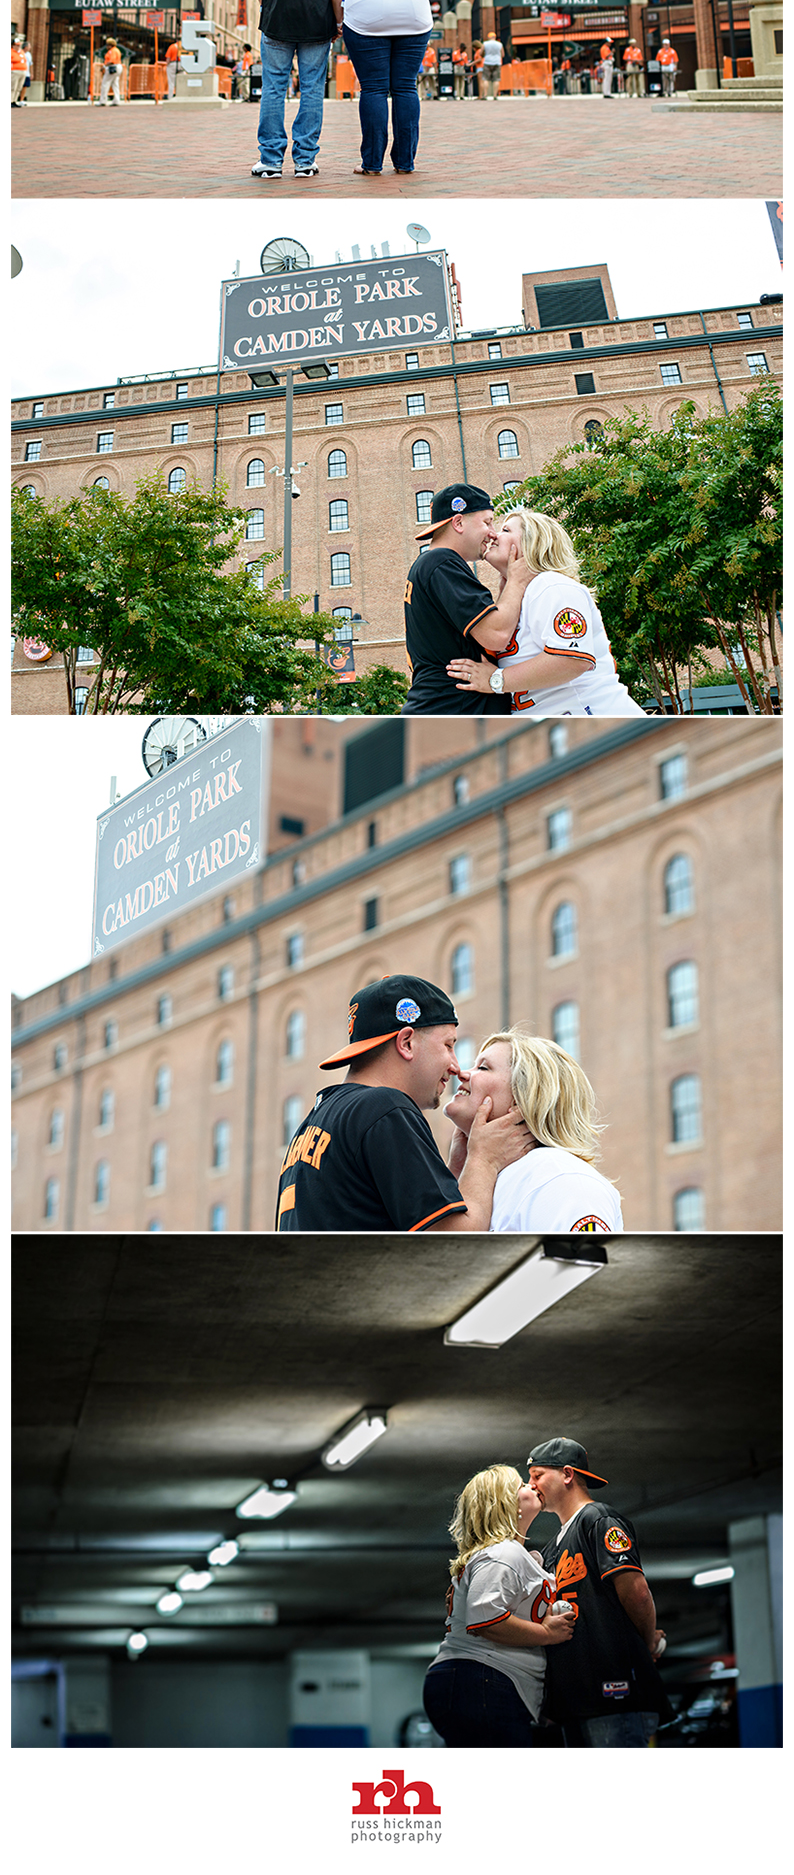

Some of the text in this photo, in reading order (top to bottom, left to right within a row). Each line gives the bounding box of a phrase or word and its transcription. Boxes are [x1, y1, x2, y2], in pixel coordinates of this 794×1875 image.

[180, 20, 216, 74] 5
[247, 276, 422, 318] ORIOLE PARK
[262, 268, 406, 294] WELCOME TO
[233, 312, 438, 358] CAMDEN YARDS
[324, 308, 343, 323] at
[123, 748, 232, 828] WELCOME TO
[113, 759, 243, 870] ORIOLE PARK
[165, 835, 181, 863] at
[102, 819, 251, 936] CAMDEN YARDS
